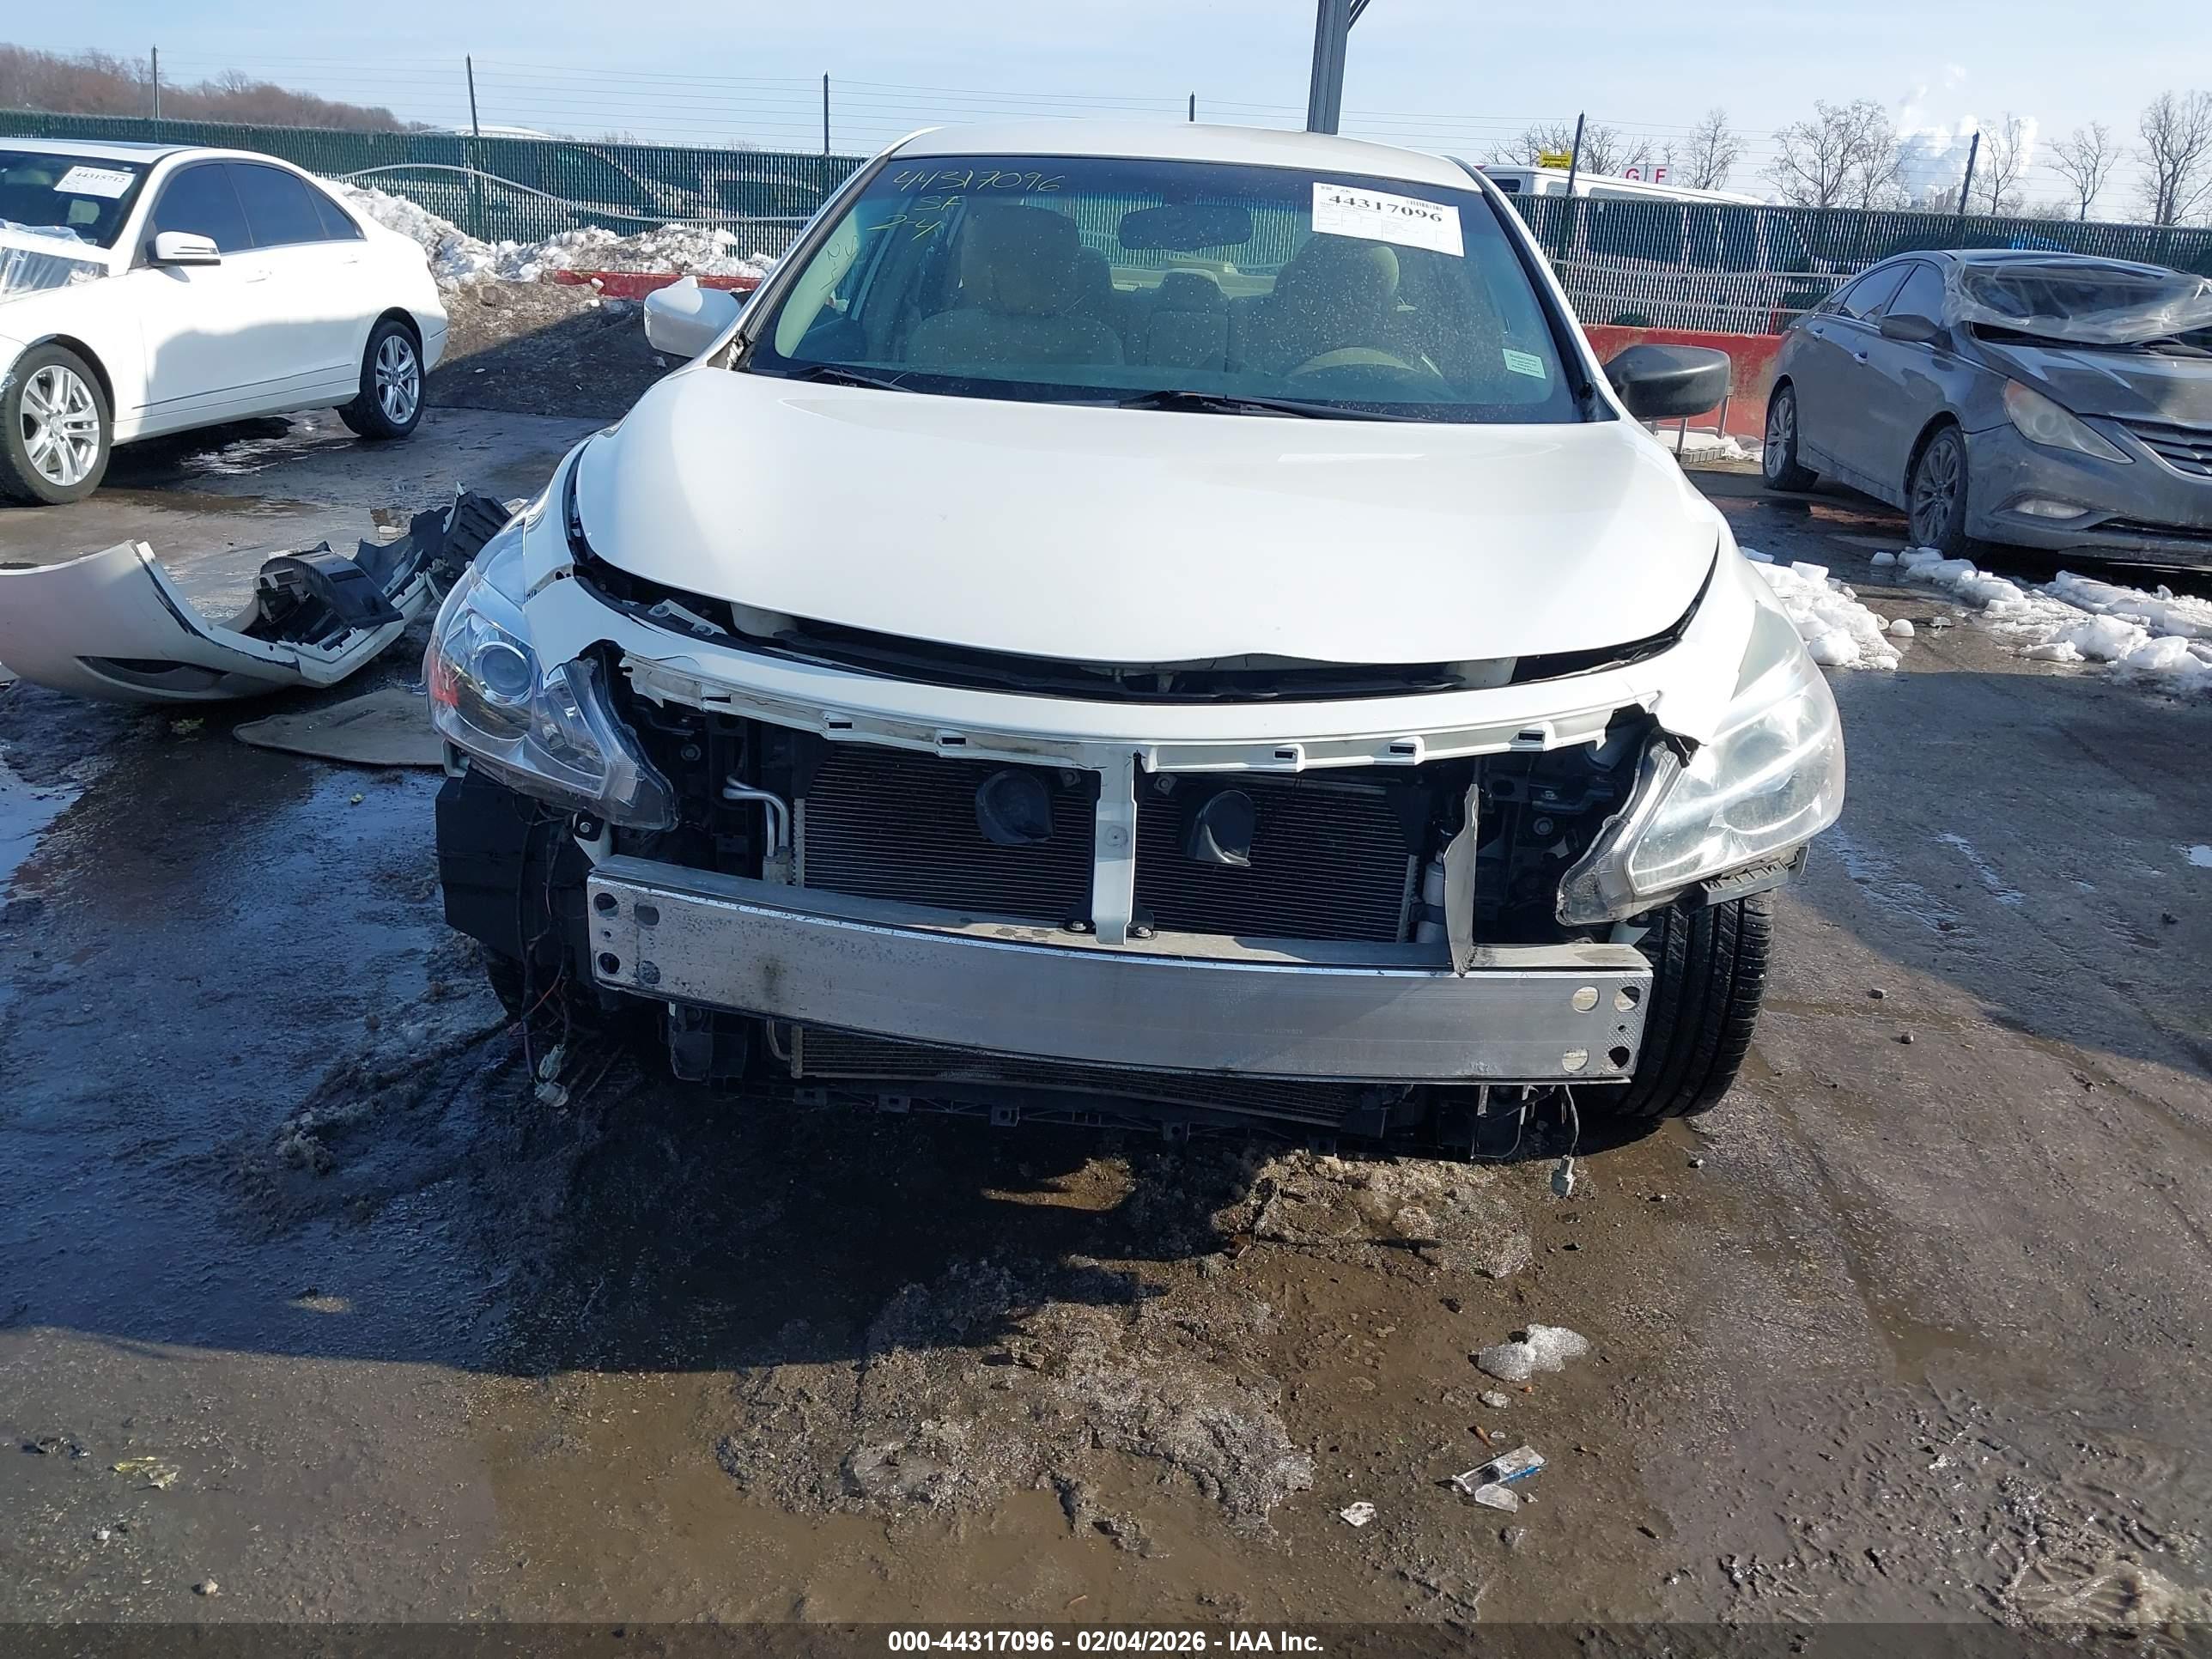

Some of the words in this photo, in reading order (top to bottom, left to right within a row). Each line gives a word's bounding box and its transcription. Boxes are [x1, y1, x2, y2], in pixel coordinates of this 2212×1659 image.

[893, 169, 1066, 193] 44317096
[1626, 167, 1639, 180] G
[1655, 168, 1667, 184] F
[1328, 195, 1443, 222] 44317096
[866, 214, 942, 241] 2-4
